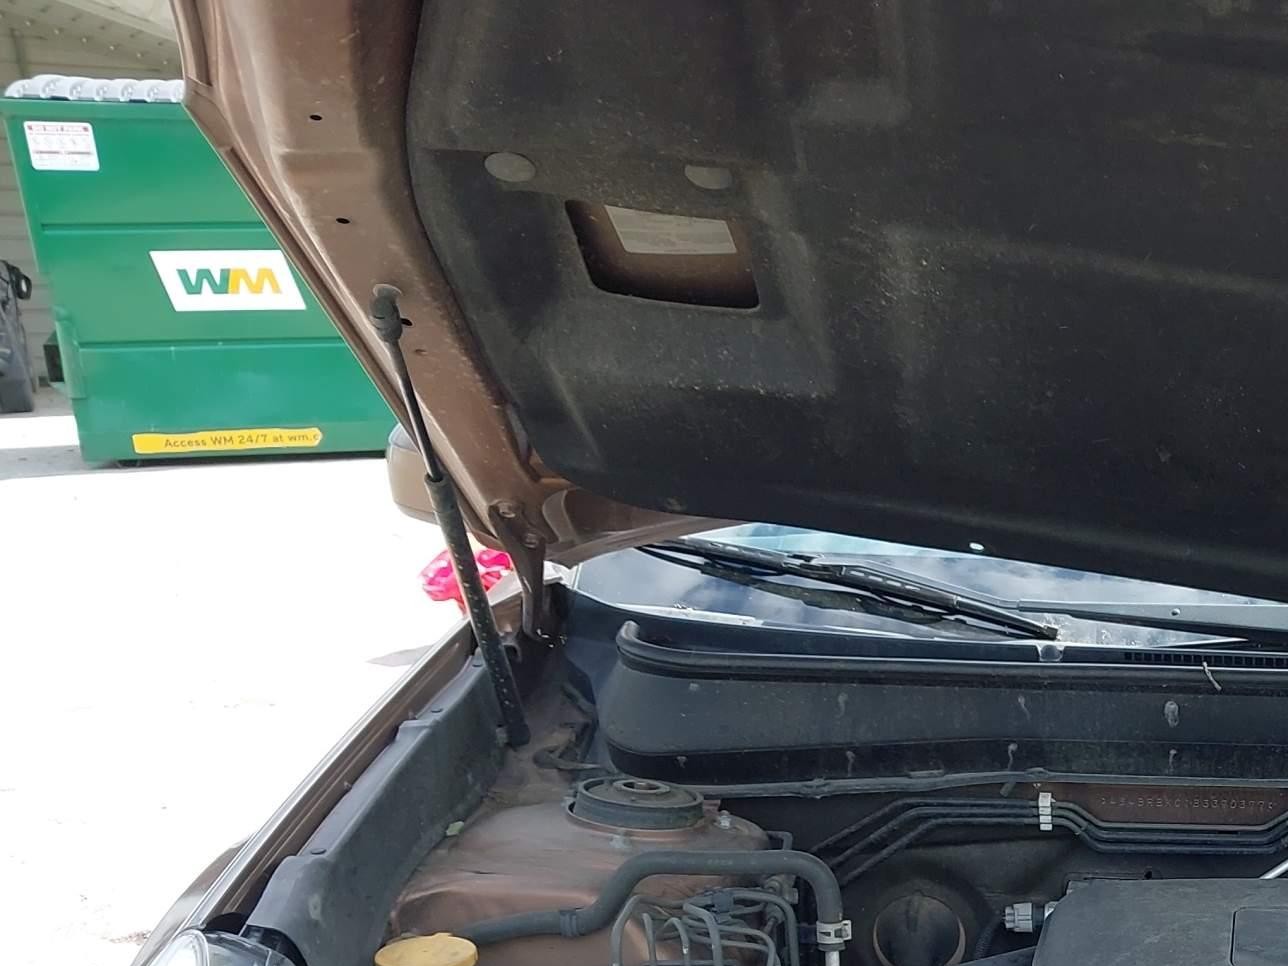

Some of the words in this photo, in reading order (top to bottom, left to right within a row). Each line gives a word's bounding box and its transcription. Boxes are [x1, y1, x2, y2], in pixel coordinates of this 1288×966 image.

[176, 268, 283, 295] WM
[164, 438, 207, 449] Access
[210, 435, 234, 446] WM
[238, 433, 267, 445] 24/7
[273, 434, 284, 443] at
